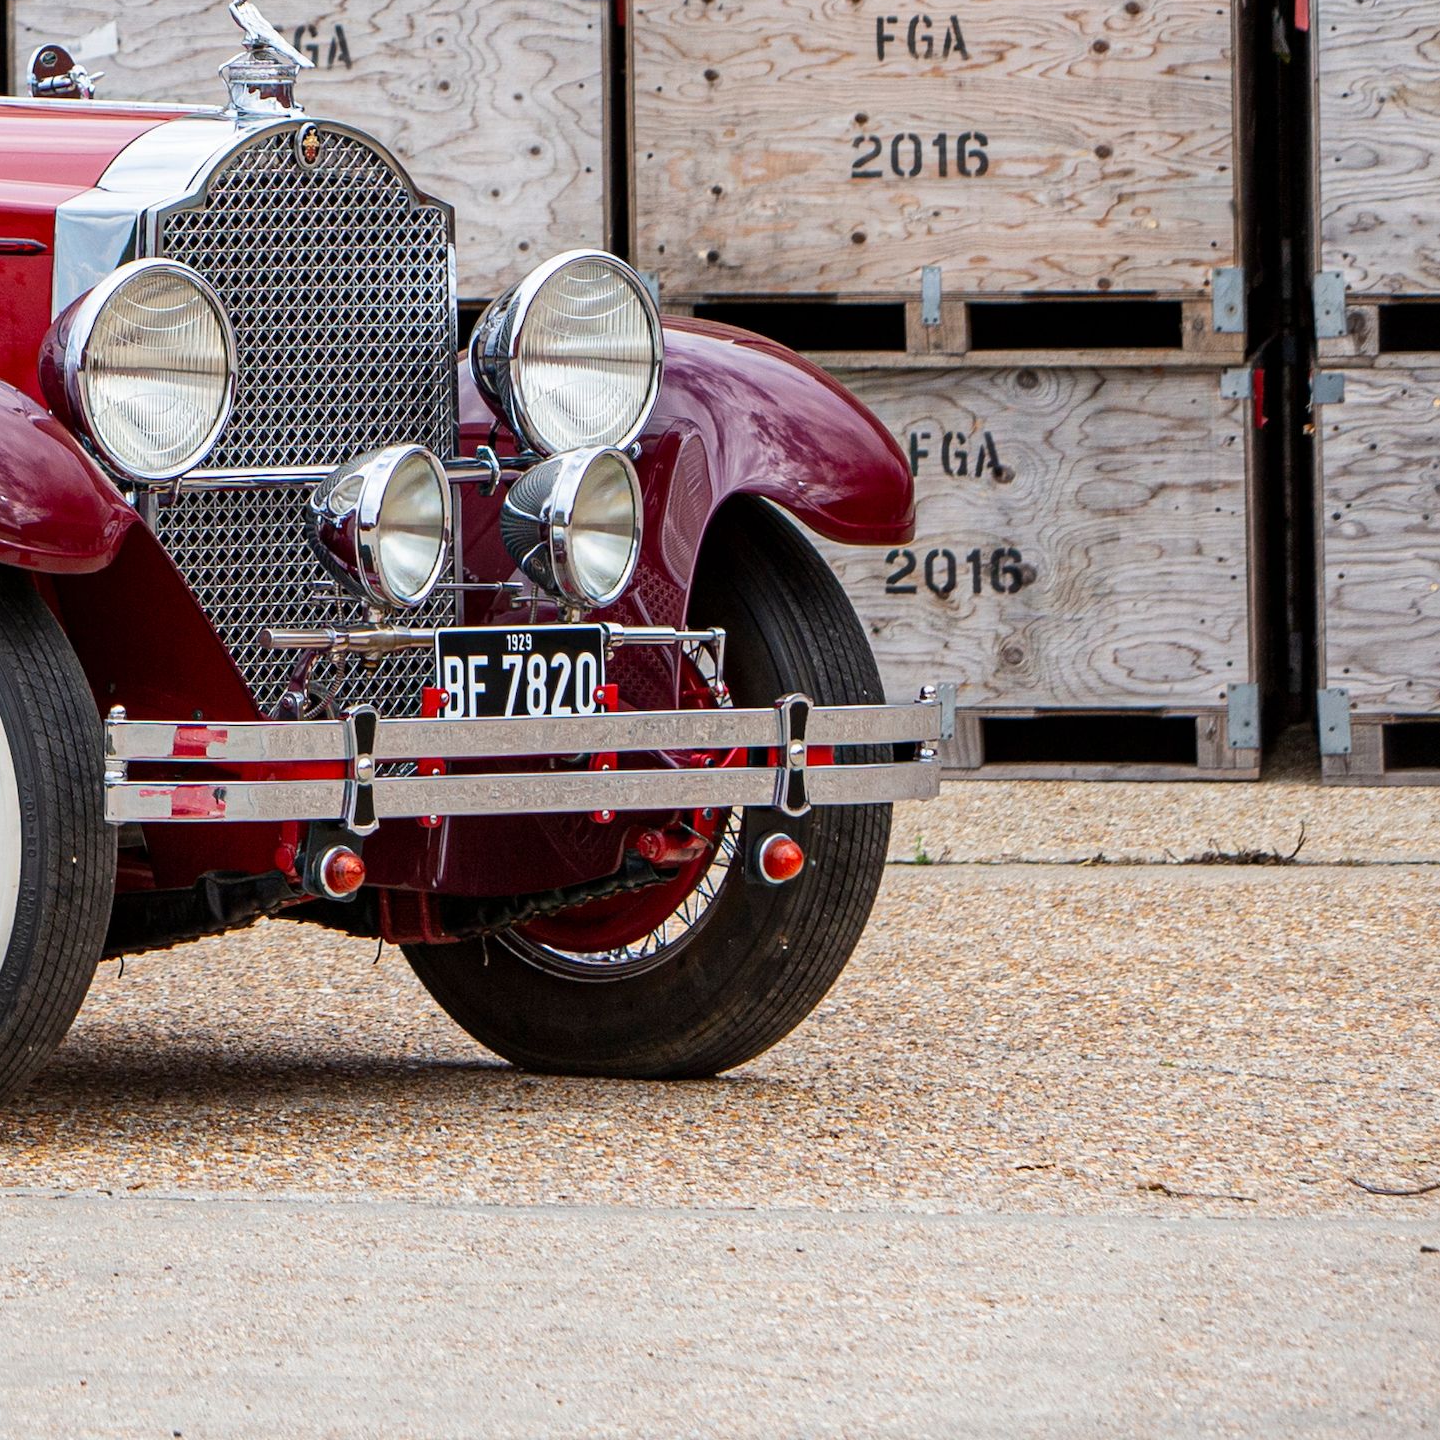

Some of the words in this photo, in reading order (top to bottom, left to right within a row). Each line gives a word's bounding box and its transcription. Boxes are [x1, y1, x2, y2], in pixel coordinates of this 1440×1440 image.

[273, 24, 351, 69] GA
[876, 15, 970, 60] FGA
[851, 132, 990, 178] 2016
[910, 432, 1003, 477] FGA
[885, 548, 1024, 595] 2016
[507, 634, 532, 651] 1929
[443, 655, 489, 718] BF
[502, 652, 597, 716] 7820
